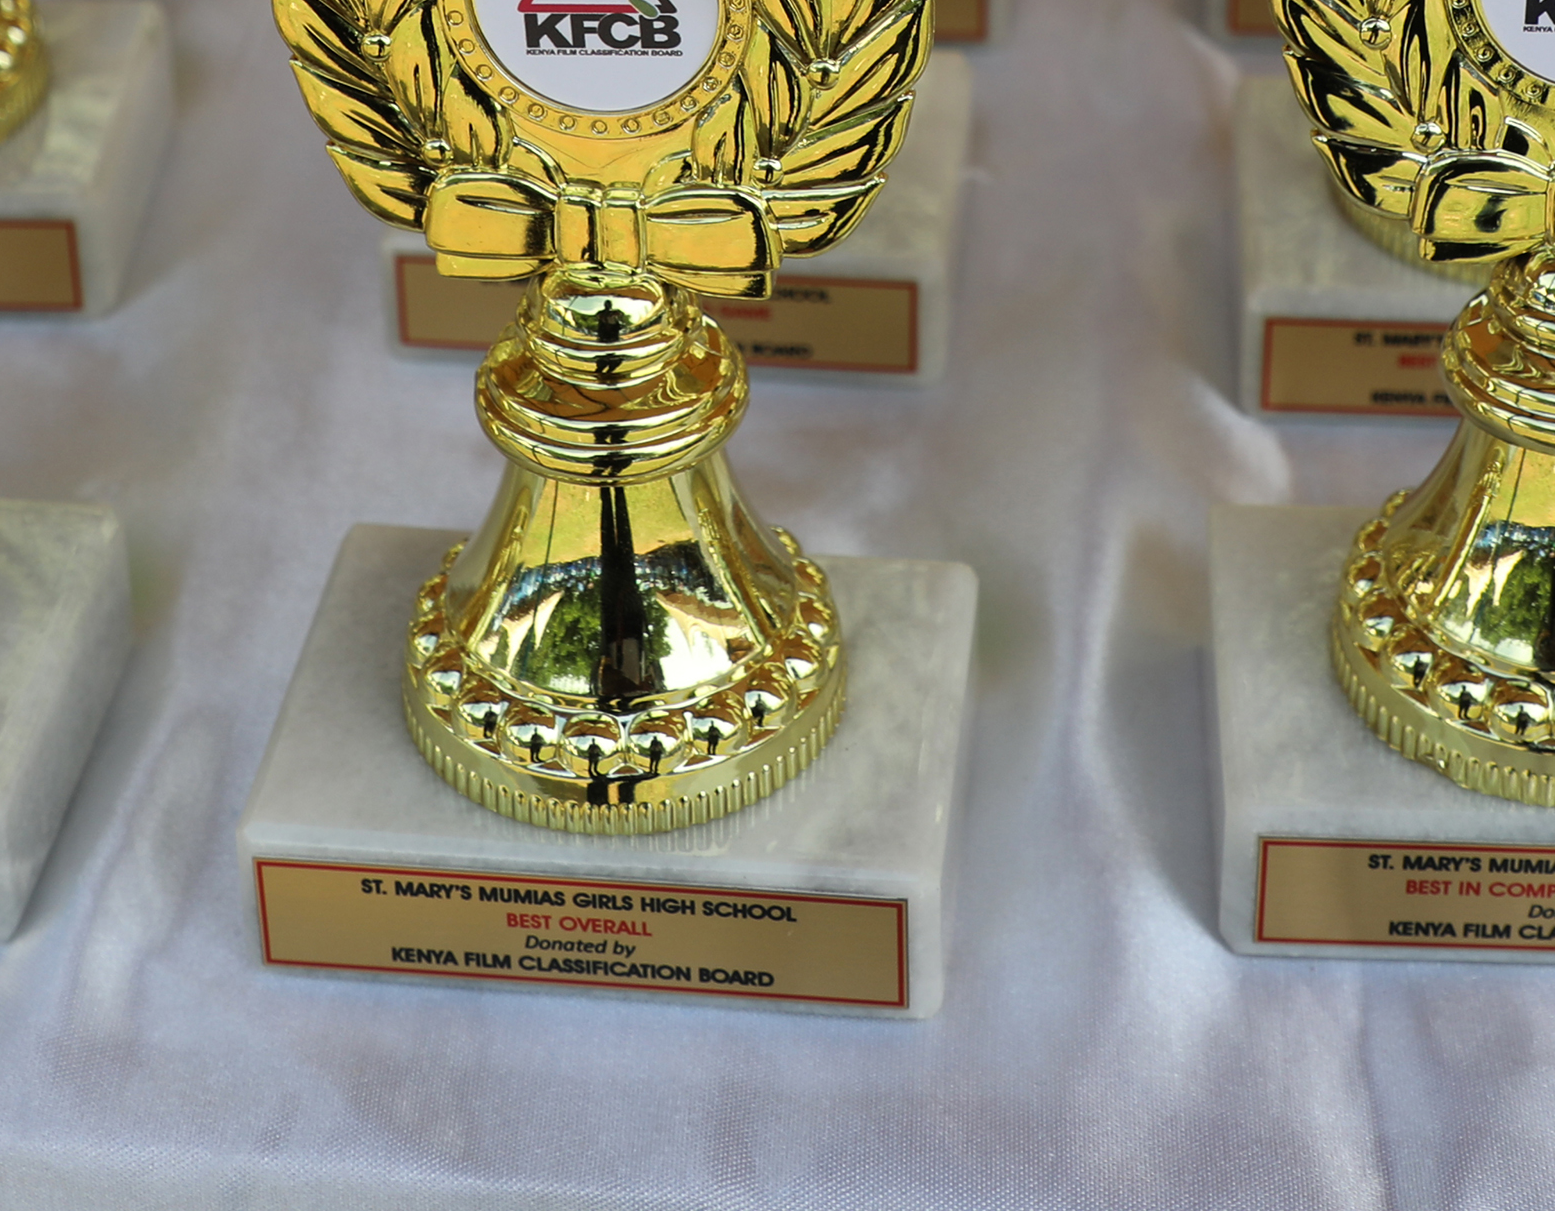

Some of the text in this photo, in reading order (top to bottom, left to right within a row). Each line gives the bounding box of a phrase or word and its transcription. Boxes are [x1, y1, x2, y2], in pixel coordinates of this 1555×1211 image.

[524, 13, 681, 49] KFCB
[1367, 854, 1396, 870] ST.
[1402, 855, 1482, 873] MARY'S
[1404, 879, 1452, 896] BEST
[1458, 881, 1481, 897] IN
[360, 878, 797, 923] ST. MARY'S MUMIAS GIRLS HIGH SCHOOL
[506, 912, 653, 937] BEST OVERALL
[1388, 920, 1458, 937] KENYA
[1462, 922, 1512, 939] FILM
[524, 934, 636, 958] Donated by
[391, 946, 774, 987] KENYA FILM CLASSIFICATION BOARD
